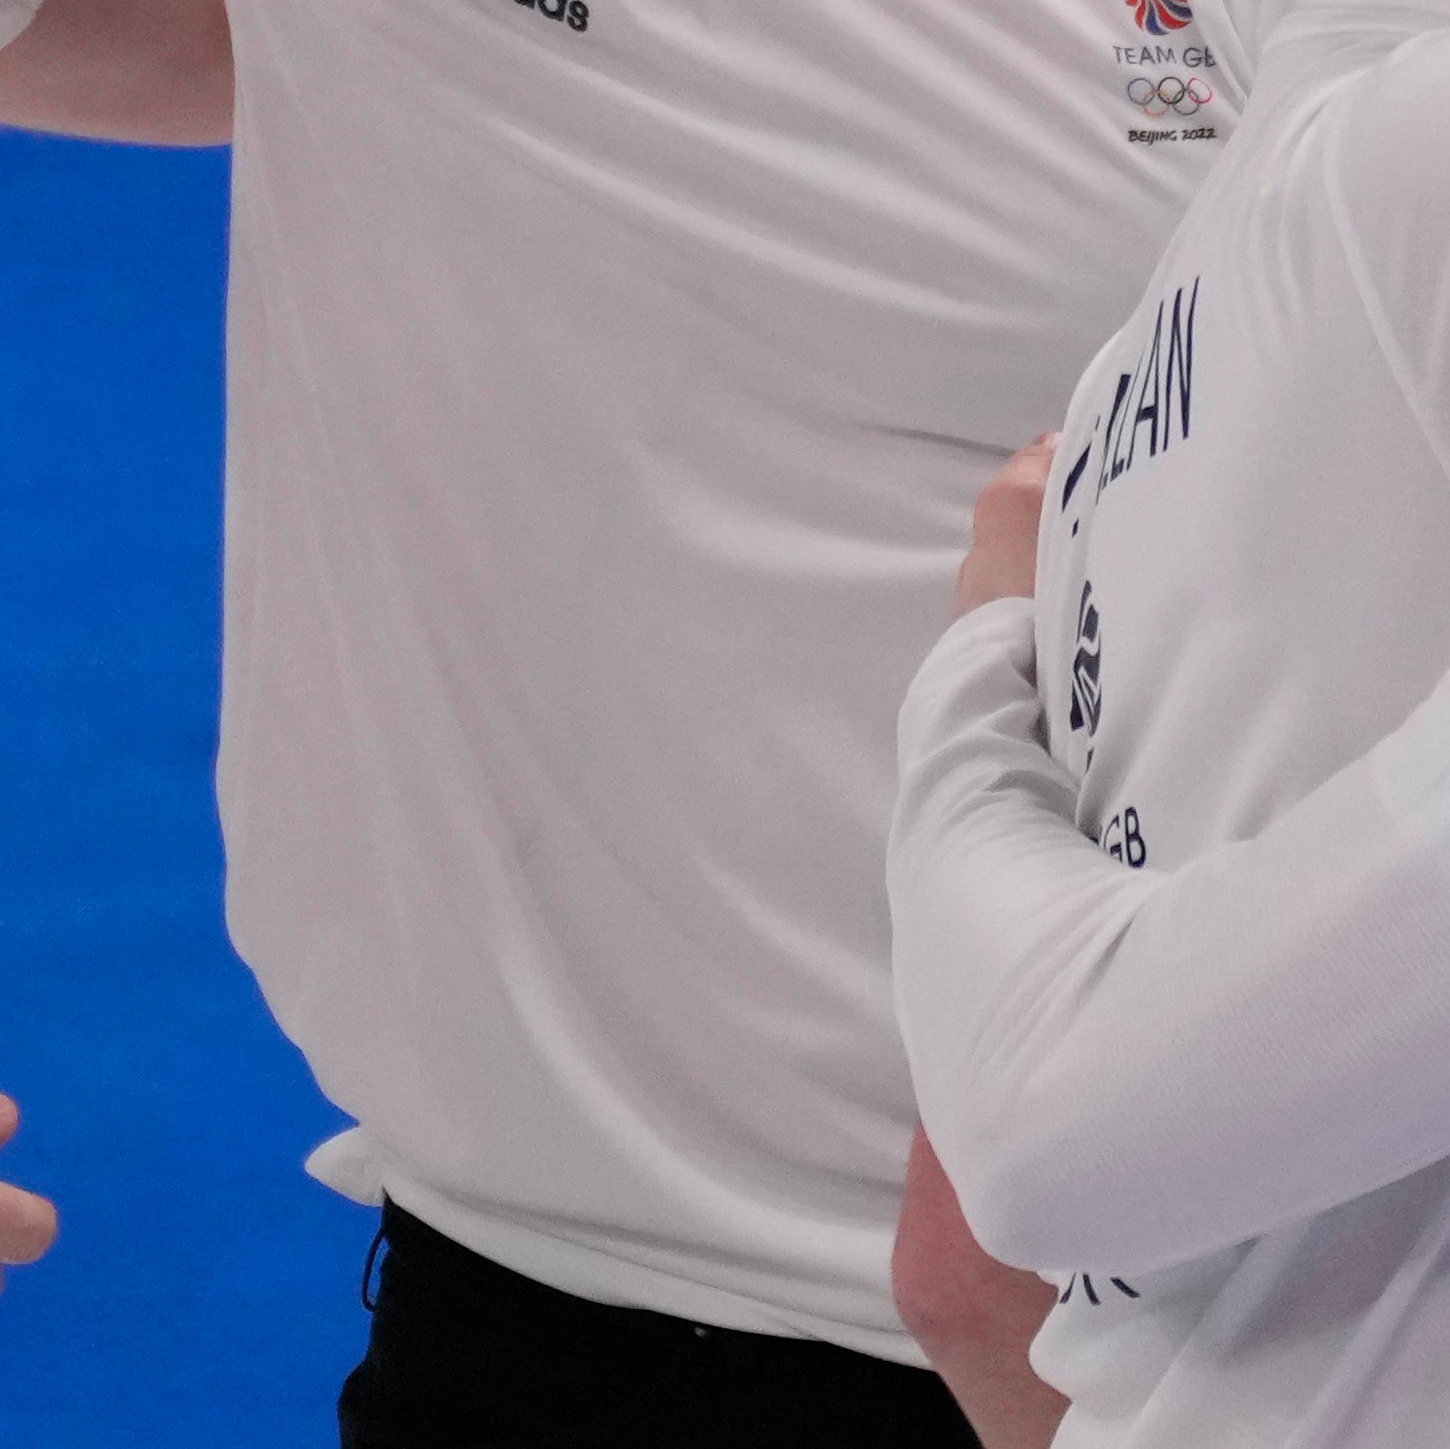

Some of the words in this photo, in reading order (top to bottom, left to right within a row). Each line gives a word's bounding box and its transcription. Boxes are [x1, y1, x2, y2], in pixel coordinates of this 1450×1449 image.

[1112, 45, 1177, 65] TEAM
[1128, 130, 1177, 145] BEIJING
[1182, 128, 1217, 140] 2022
